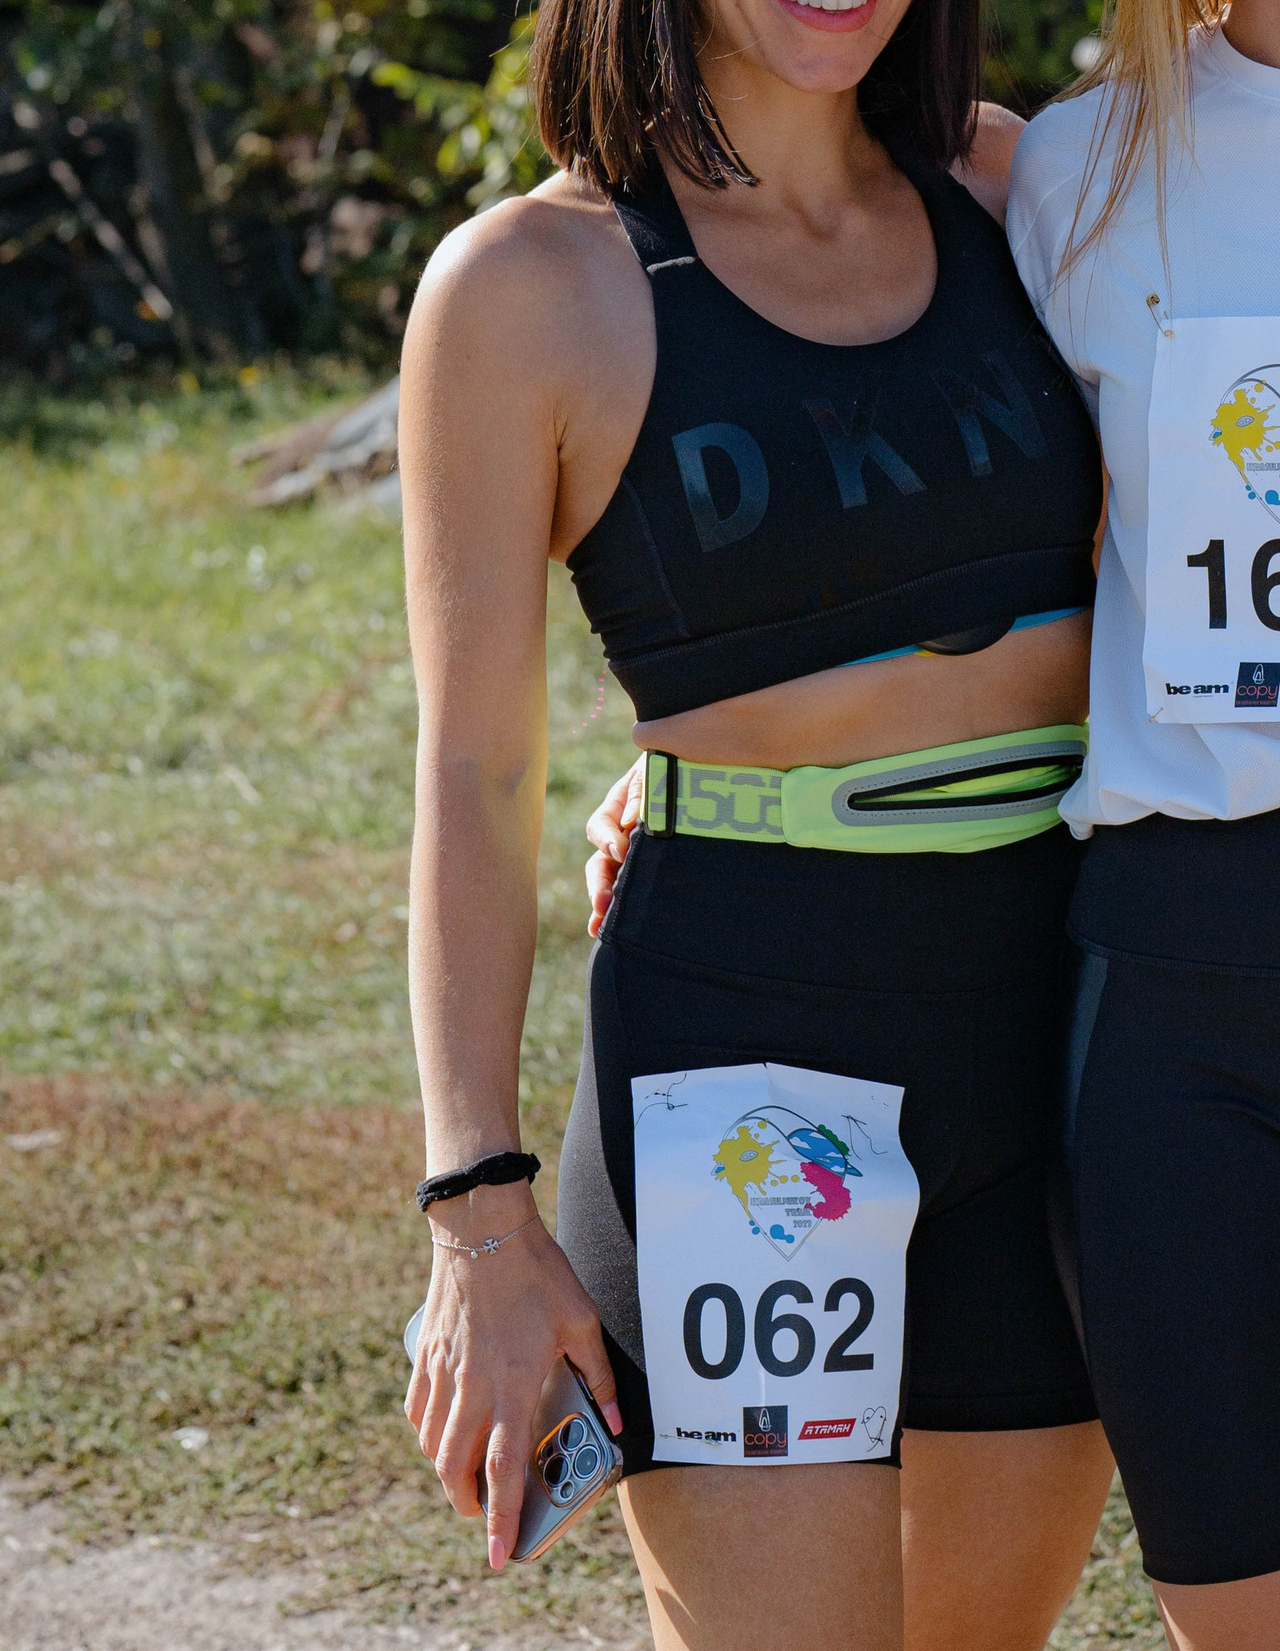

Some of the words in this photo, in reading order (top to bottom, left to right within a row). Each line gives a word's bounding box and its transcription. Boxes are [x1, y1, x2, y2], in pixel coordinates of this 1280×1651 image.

[1236, 685, 1278, 700] copy
[683, 1277, 875, 1380] 062
[744, 1432, 787, 1448] copy
